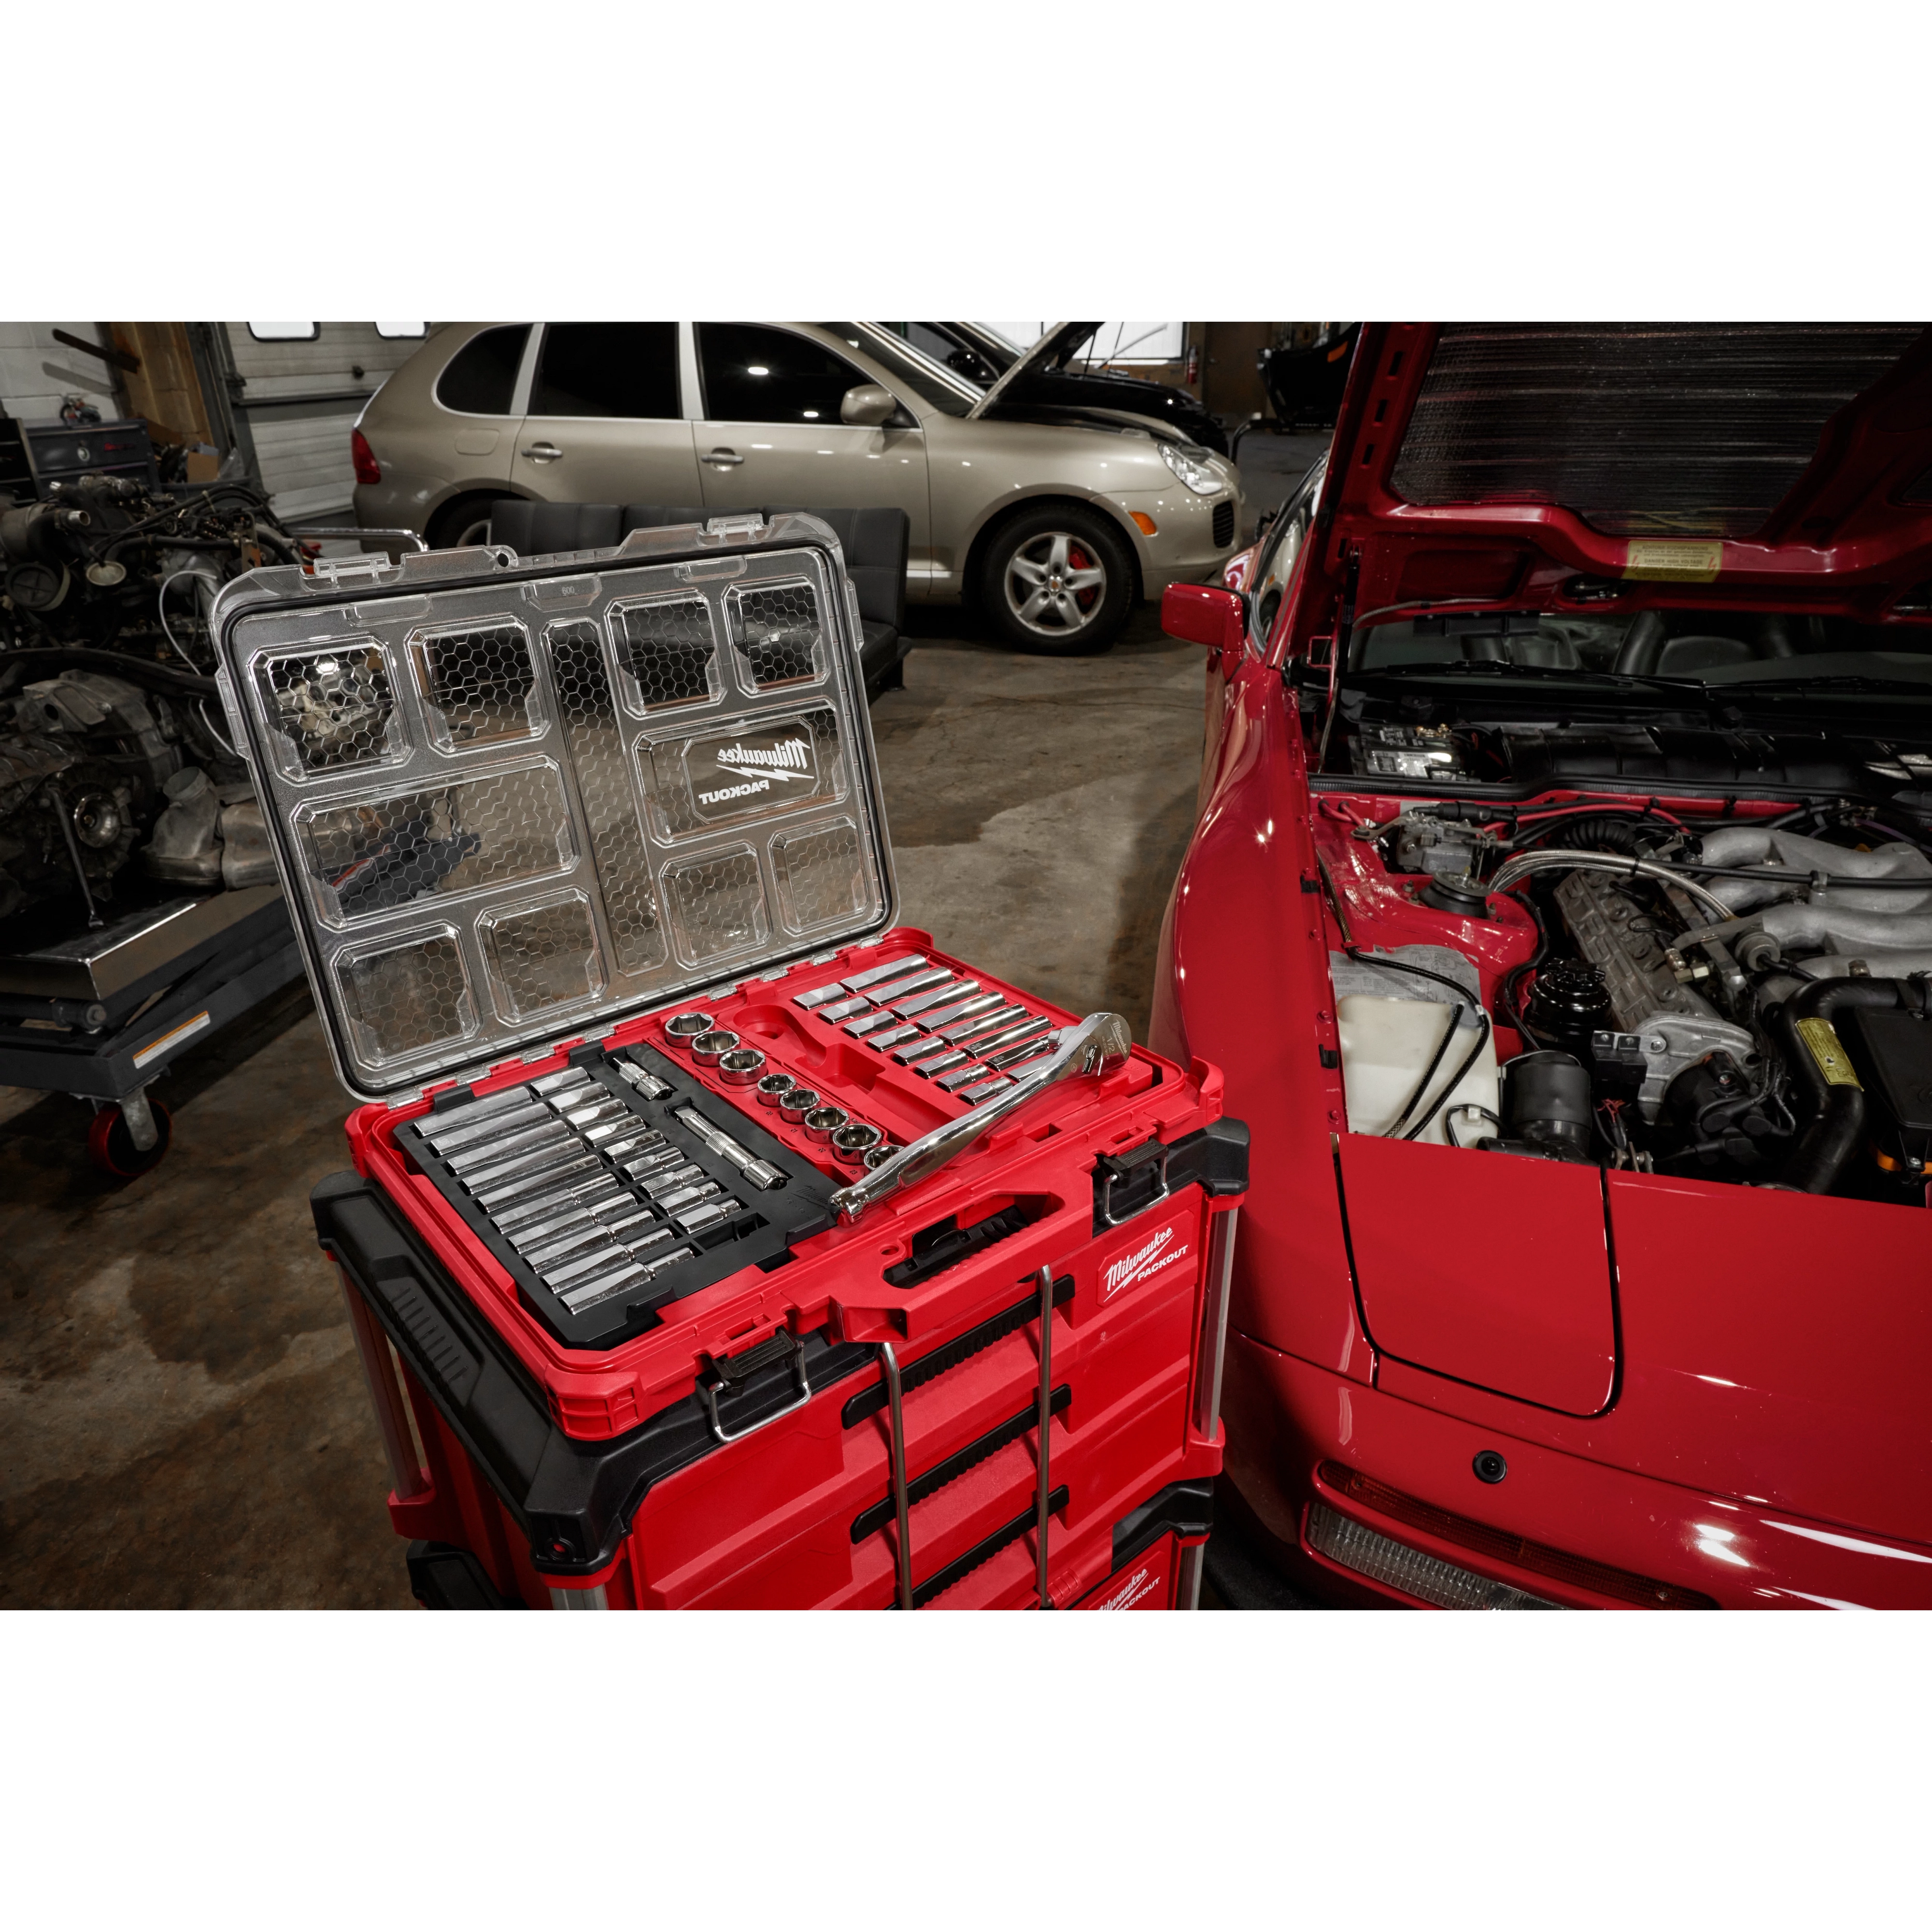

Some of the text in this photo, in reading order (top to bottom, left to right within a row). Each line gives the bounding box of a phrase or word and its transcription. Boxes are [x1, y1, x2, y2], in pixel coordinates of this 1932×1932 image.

[562, 586, 575, 595] 600
[1102, 1036, 1110, 1060] 48-22-9012
[1107, 1036, 1115, 1053] 1/2
[1112, 1019, 1128, 1054] Milwaukee
[1103, 1227, 1173, 1292] Milwaukee
[1137, 1244, 1188, 1281] PACKOUT
